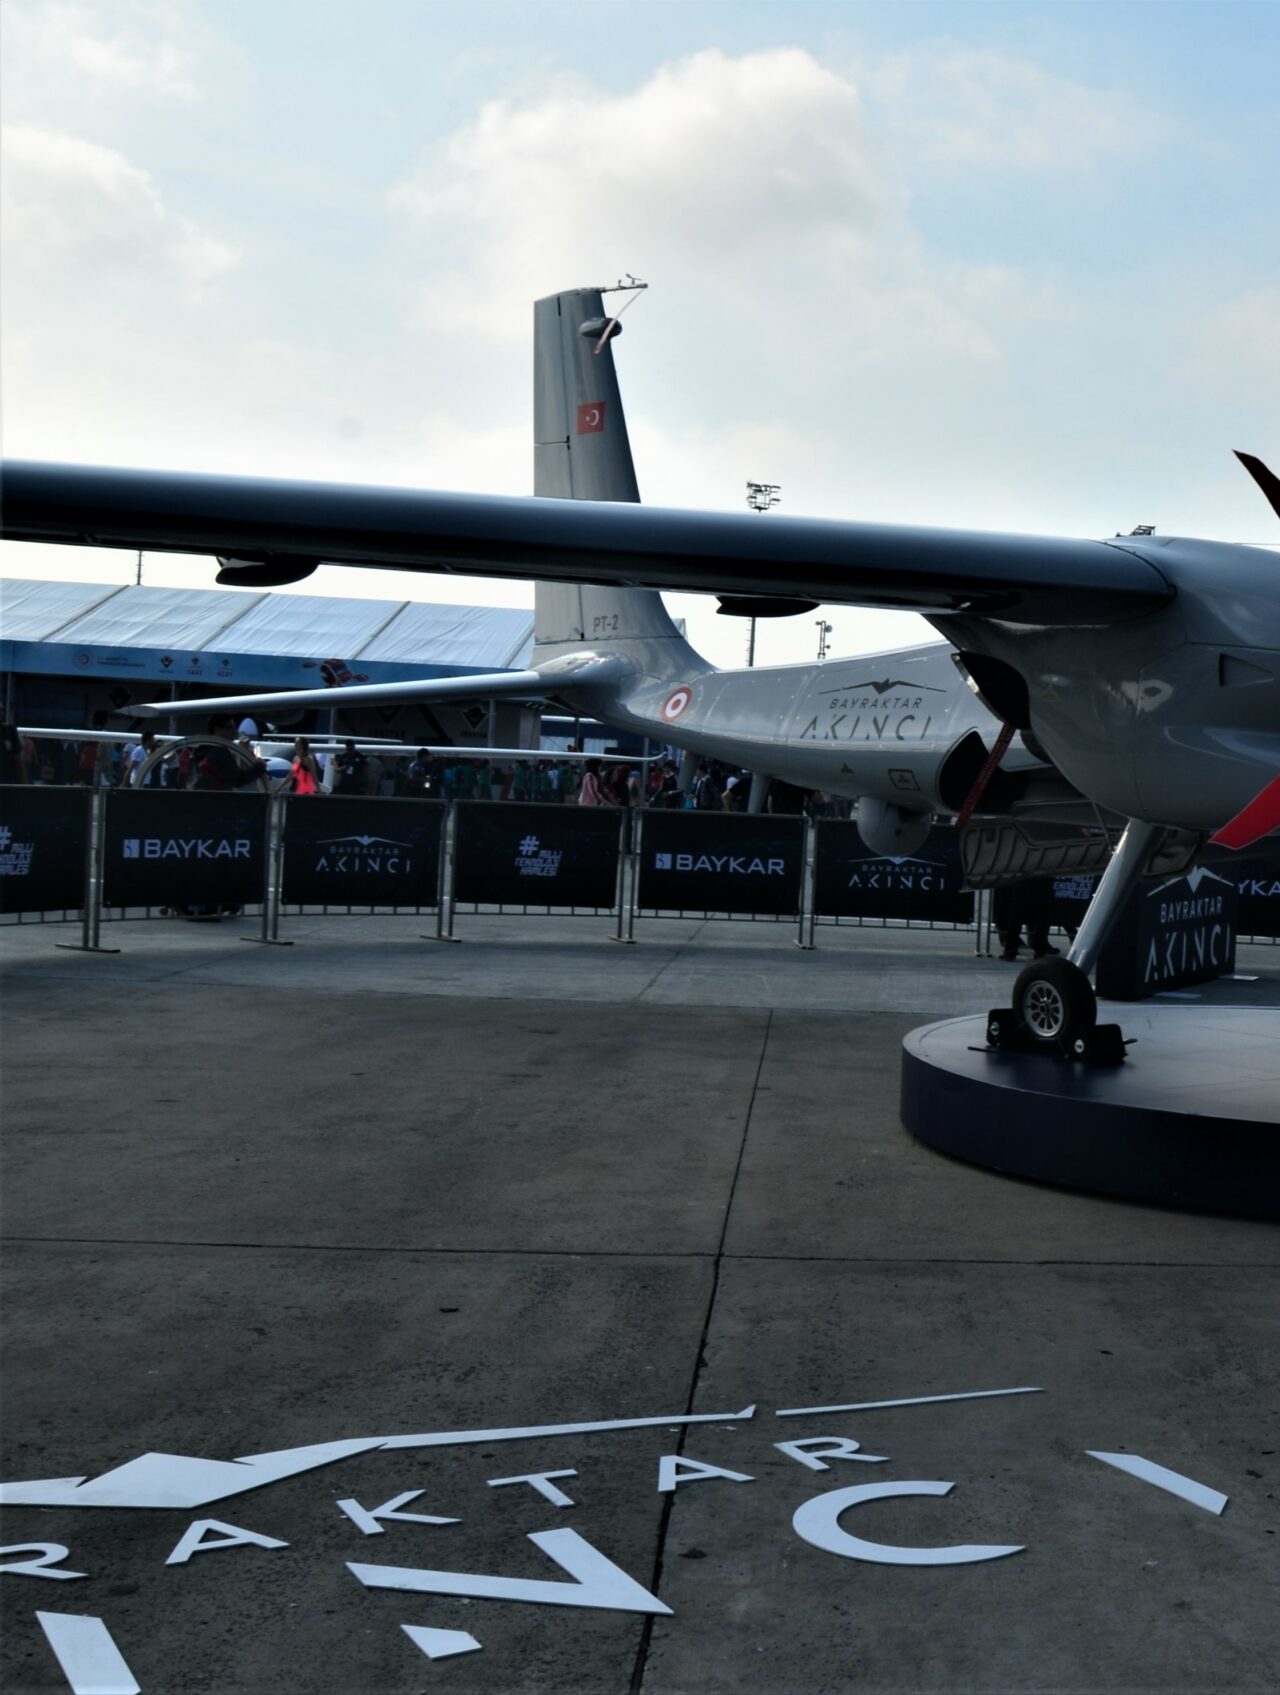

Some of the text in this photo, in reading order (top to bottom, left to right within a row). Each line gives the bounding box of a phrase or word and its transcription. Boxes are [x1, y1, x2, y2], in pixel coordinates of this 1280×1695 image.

[593, 615, 619, 633] PT-2
[829, 697, 923, 710] BAYRAKTAR
[799, 714, 932, 741] AKINCI
[144, 838, 251, 860] BAYKAR
[329, 846, 400, 855] BAYRAKTAR
[315, 855, 411, 874] AKINCI
[676, 853, 785, 877] BAYKAR
[861, 864, 933, 874] BAYRAKTAR
[847, 873, 945, 890] AKINCI
[1160, 895, 1223, 924] BAYRAKTAR
[1143, 923, 1231, 984] AKINCI
